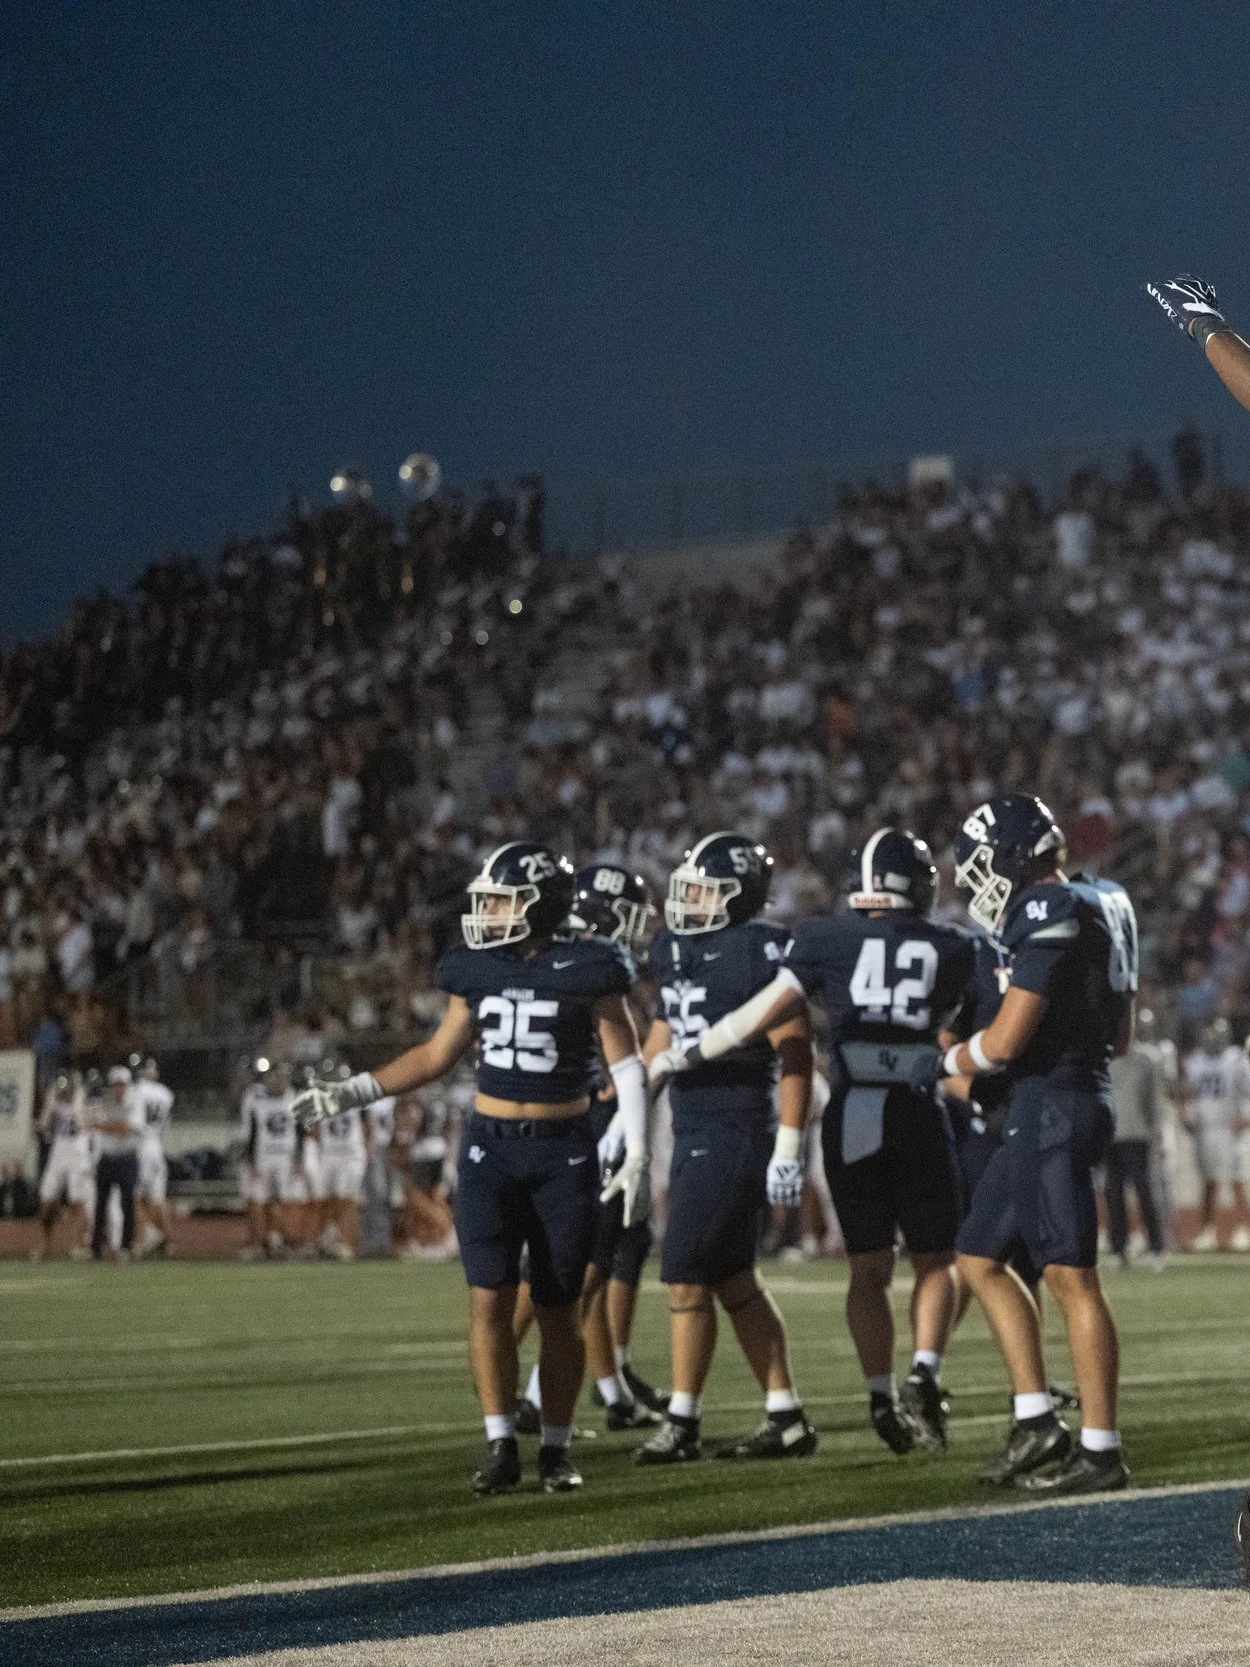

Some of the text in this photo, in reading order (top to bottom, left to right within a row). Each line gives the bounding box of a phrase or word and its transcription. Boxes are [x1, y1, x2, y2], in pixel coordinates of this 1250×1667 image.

[963, 803, 996, 841] 87
[518, 851, 556, 884] 25
[593, 868, 626, 896] 88
[849, 938, 938, 1030] 42
[478, 995, 560, 1073] 25
